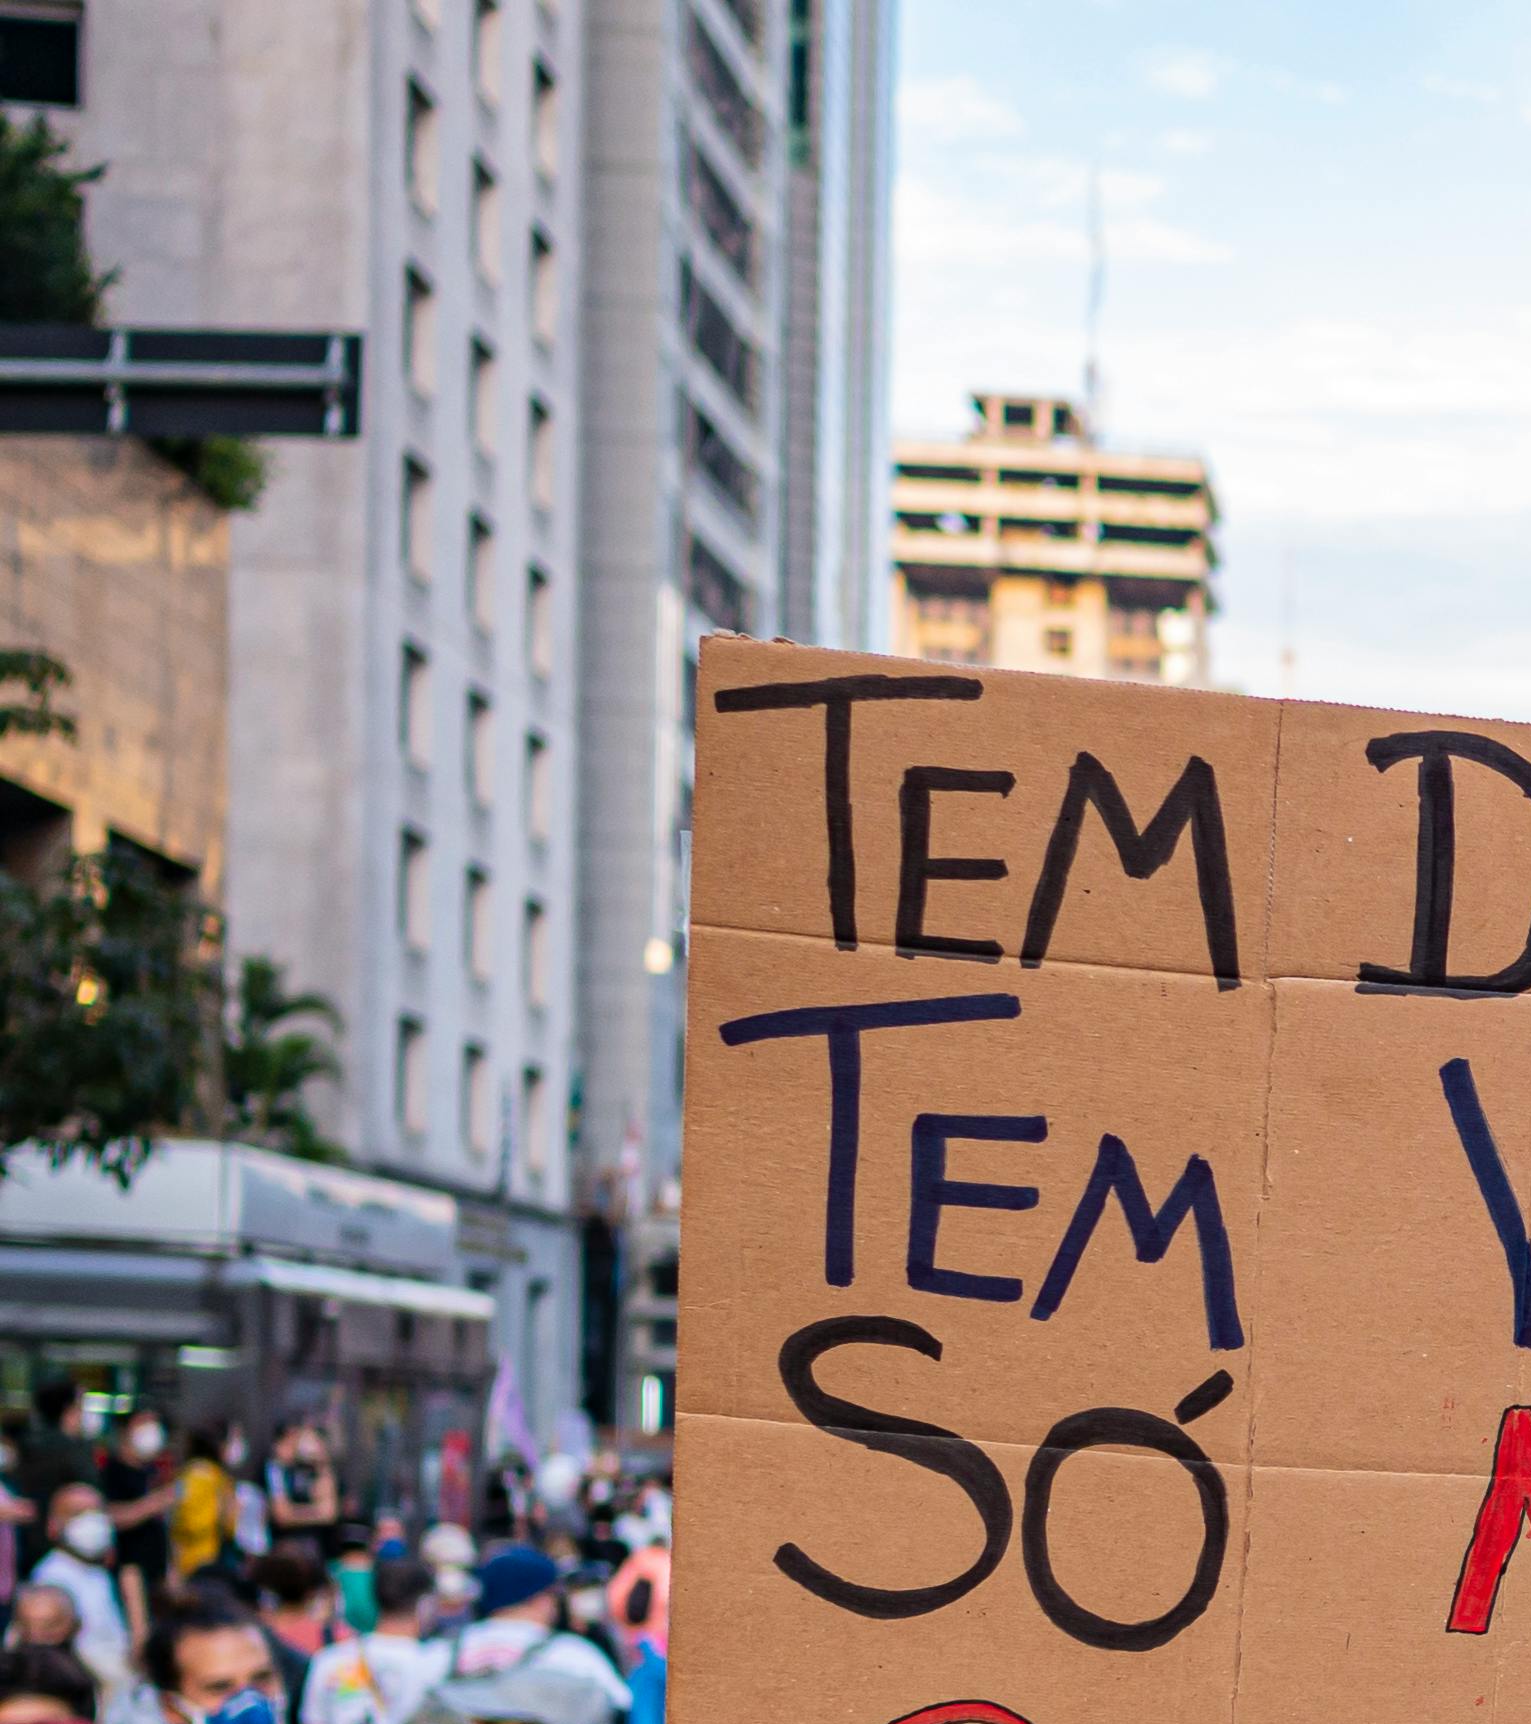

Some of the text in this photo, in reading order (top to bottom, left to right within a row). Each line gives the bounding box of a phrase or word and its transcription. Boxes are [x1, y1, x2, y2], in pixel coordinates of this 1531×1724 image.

[716, 677, 1240, 989] TEM
[720, 994, 1243, 1350] TEM
[773, 1315, 1234, 1650] SÓ
